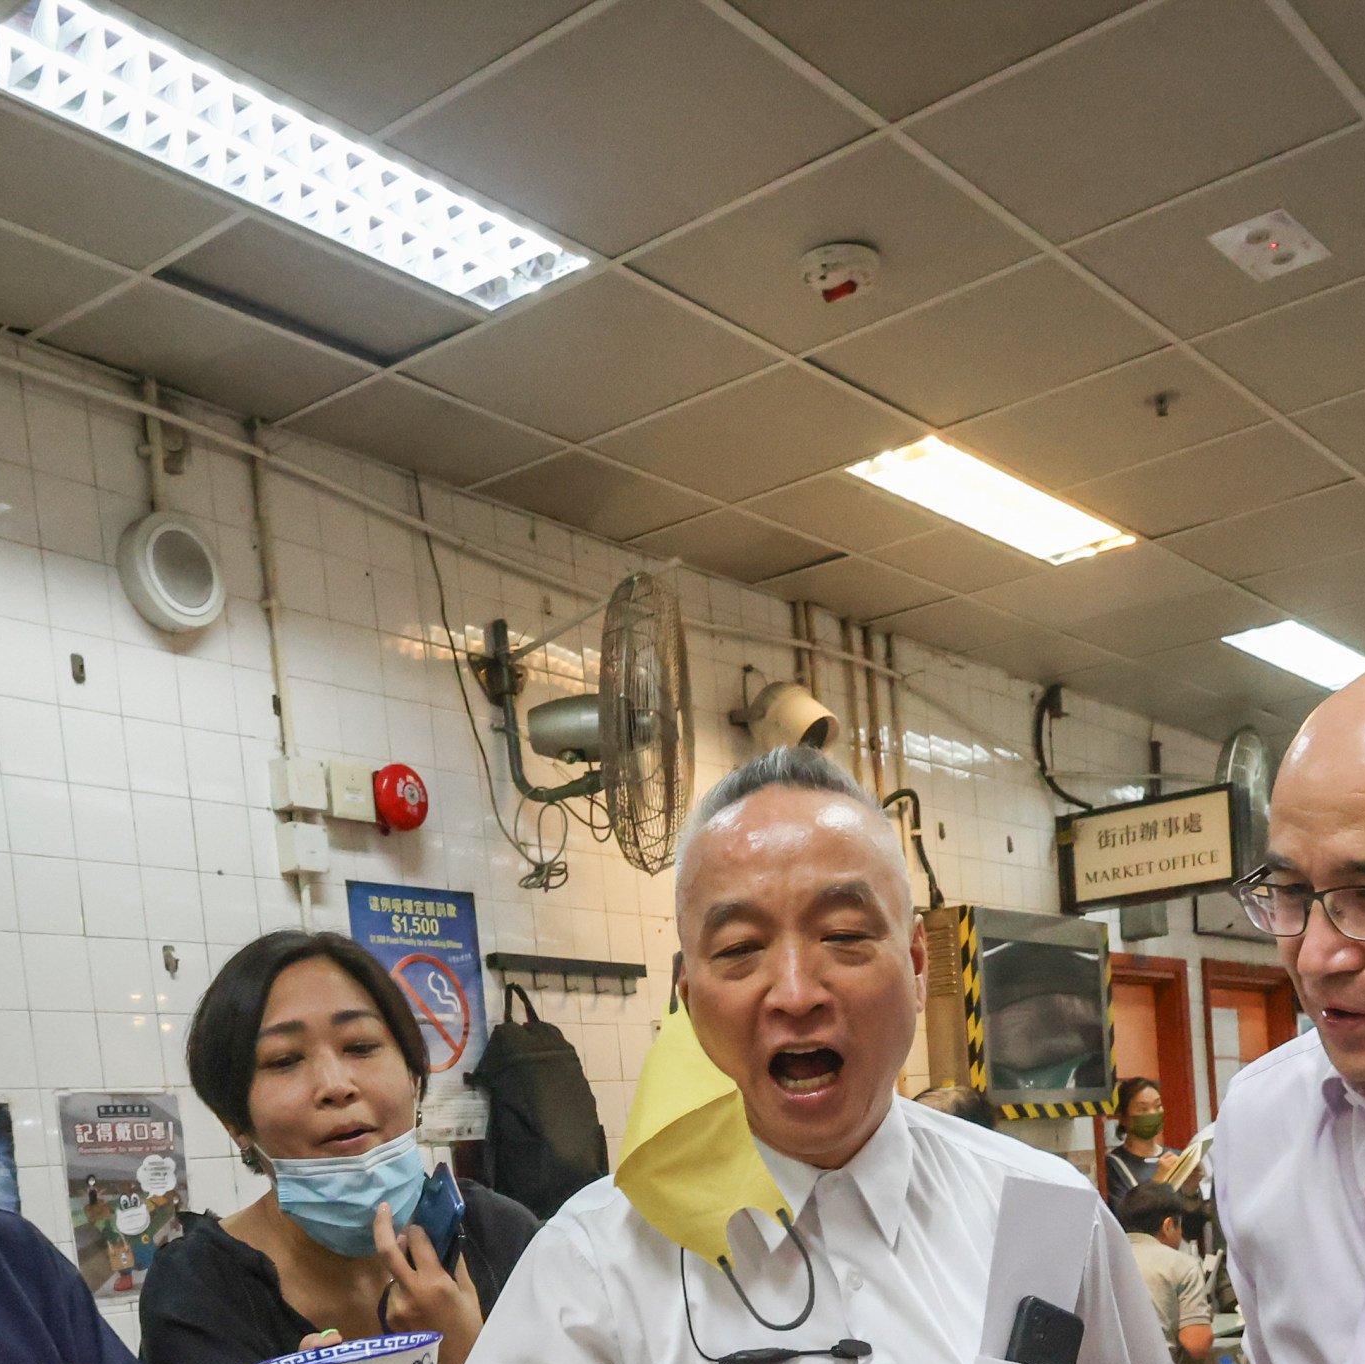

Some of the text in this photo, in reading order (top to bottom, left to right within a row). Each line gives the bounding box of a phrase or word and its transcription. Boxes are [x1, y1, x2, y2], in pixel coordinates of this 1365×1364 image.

[1098, 812, 1202, 849] 街市辦事處
[1085, 850, 1219, 885] MARKET OFFICE
[391, 914, 440, 937] $1,500
